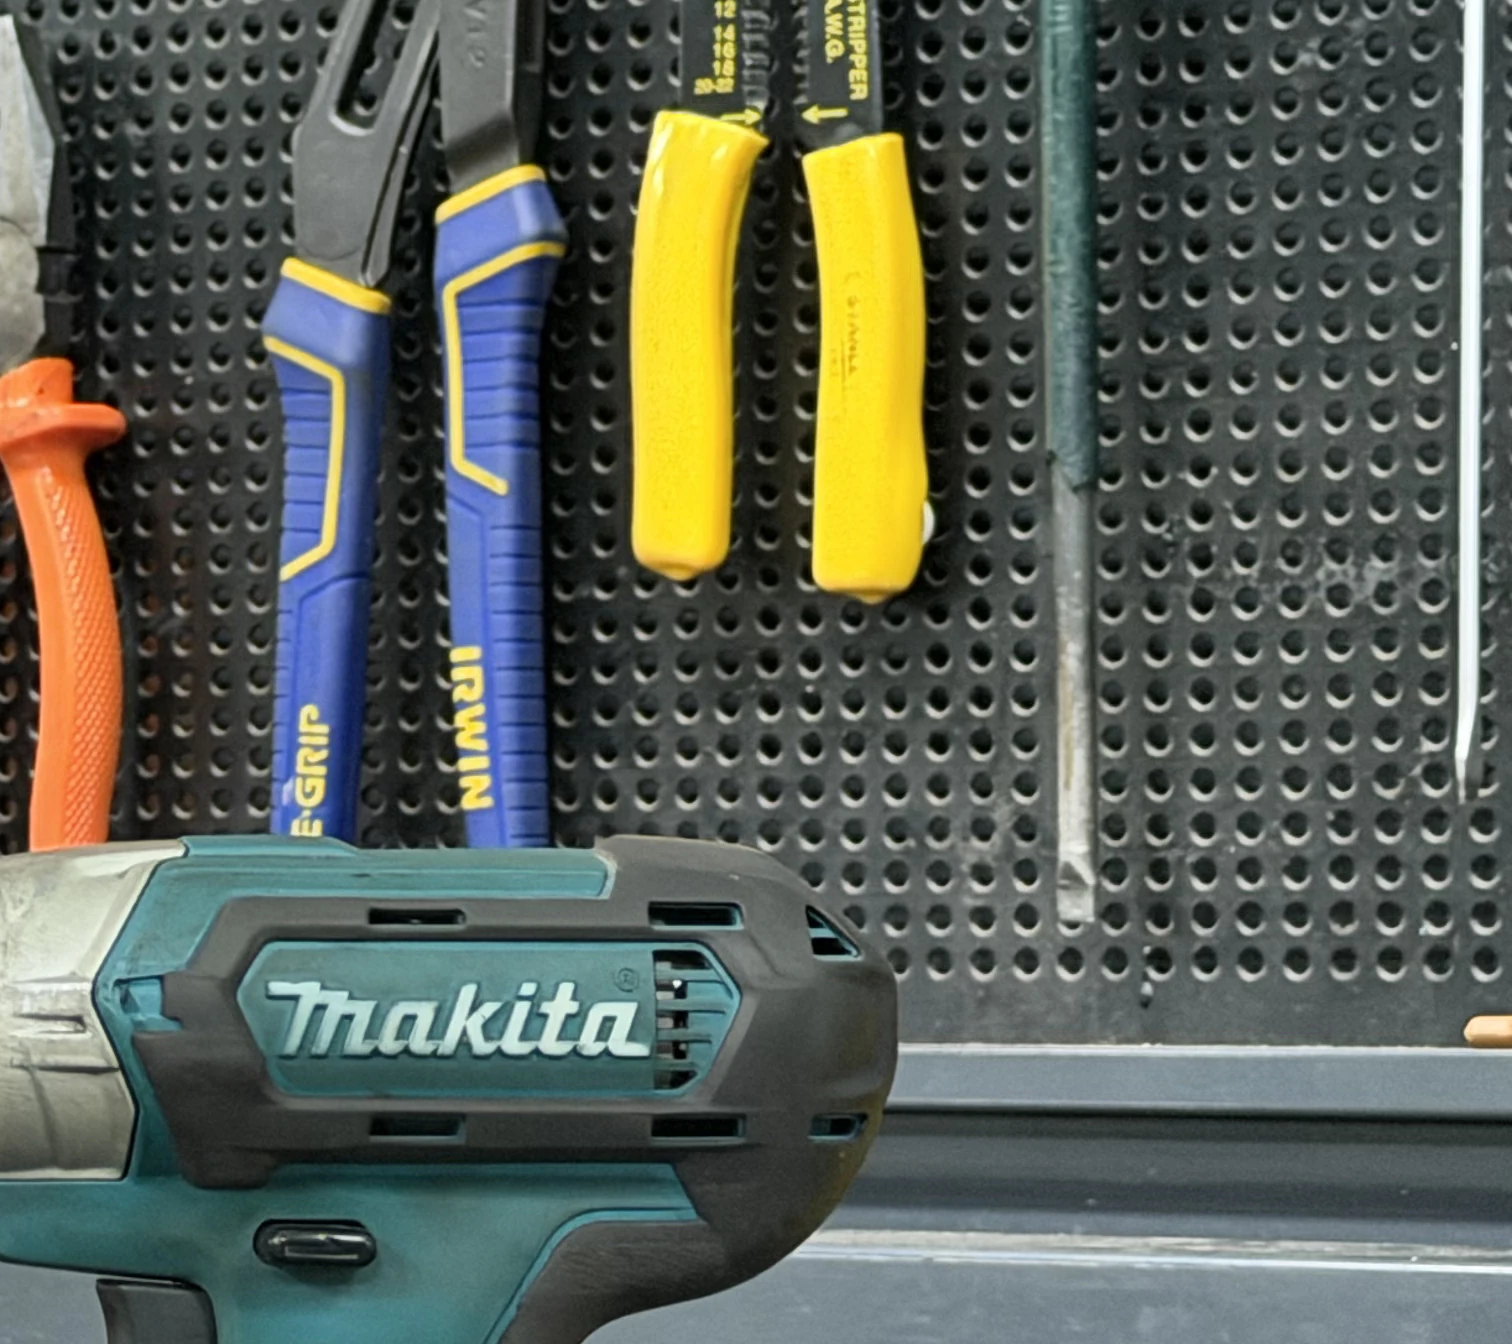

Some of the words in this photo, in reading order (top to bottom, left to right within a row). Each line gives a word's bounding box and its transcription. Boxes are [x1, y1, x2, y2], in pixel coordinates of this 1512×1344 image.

[714, 0, 737, 19] 12
[712, 23, 736, 42] 14
[713, 41, 736, 59] 16
[449, 646, 494, 811] IRWIN
